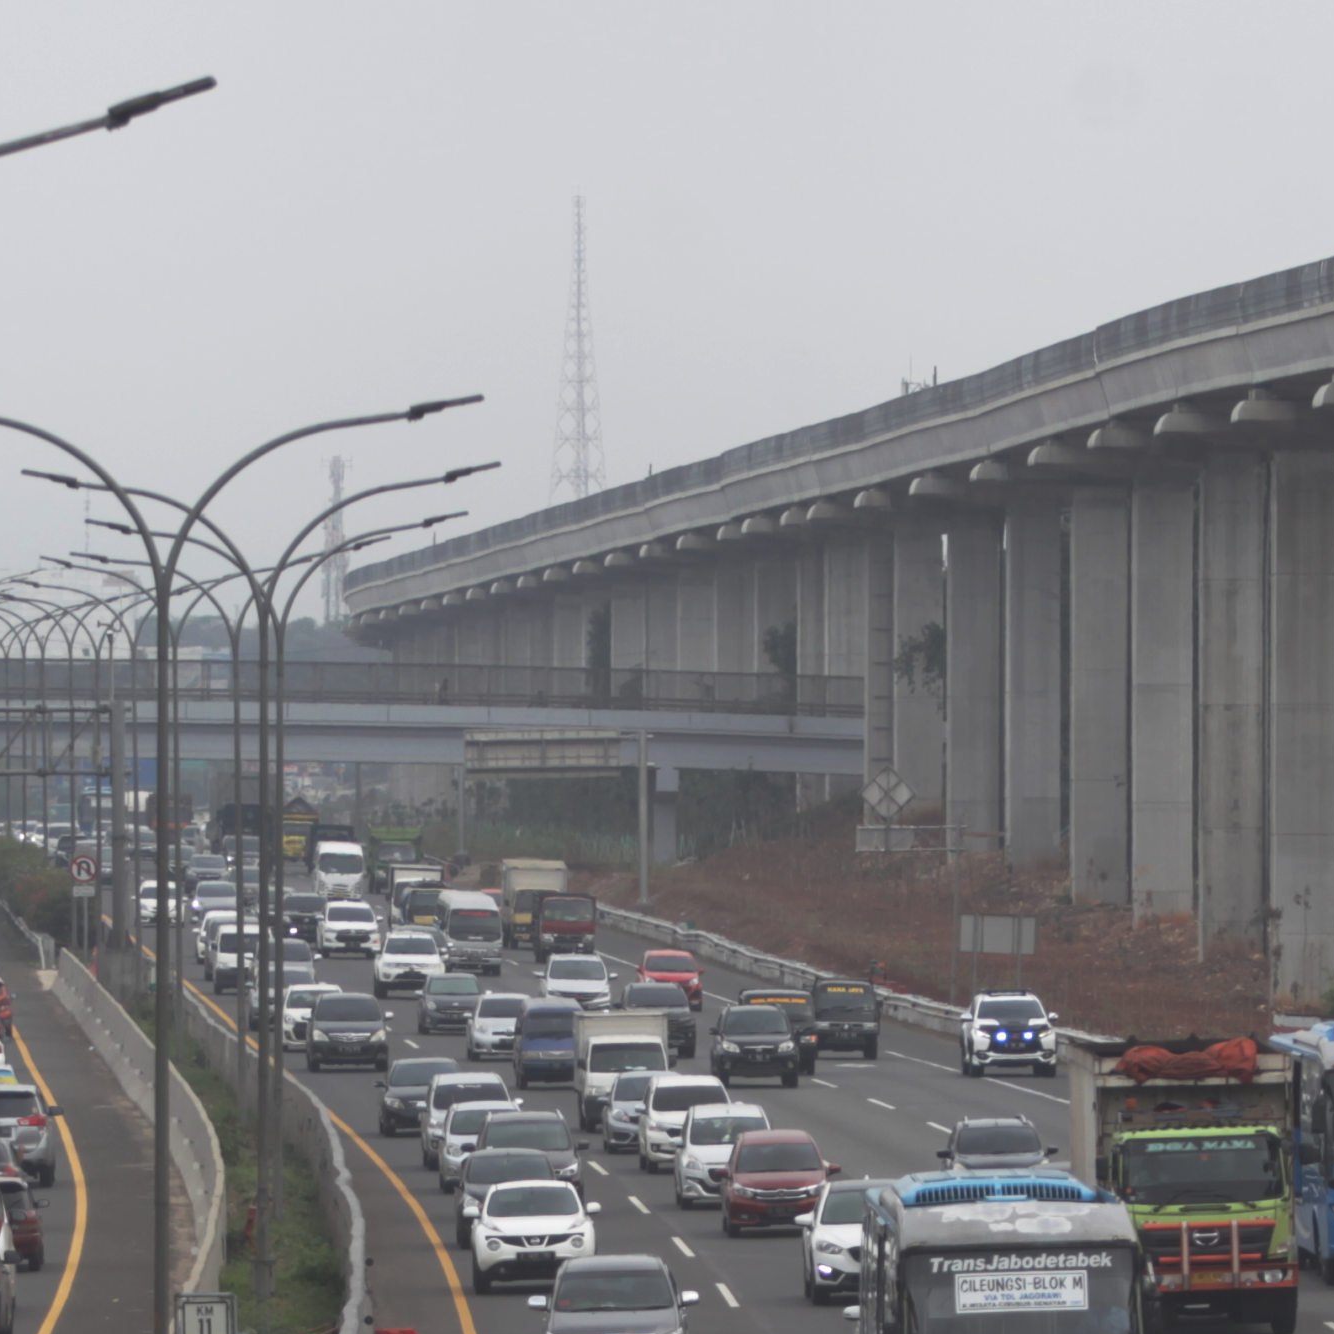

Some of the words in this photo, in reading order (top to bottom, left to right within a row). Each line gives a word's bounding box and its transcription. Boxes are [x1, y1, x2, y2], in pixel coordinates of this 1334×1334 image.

[930, 1252, 1113, 1273] TransJabodetabek
[960, 1277, 1067, 1293] CILEUNGSI-BLOK
[1072, 1276, 1083, 1289] M
[197, 1305, 213, 1316] KM
